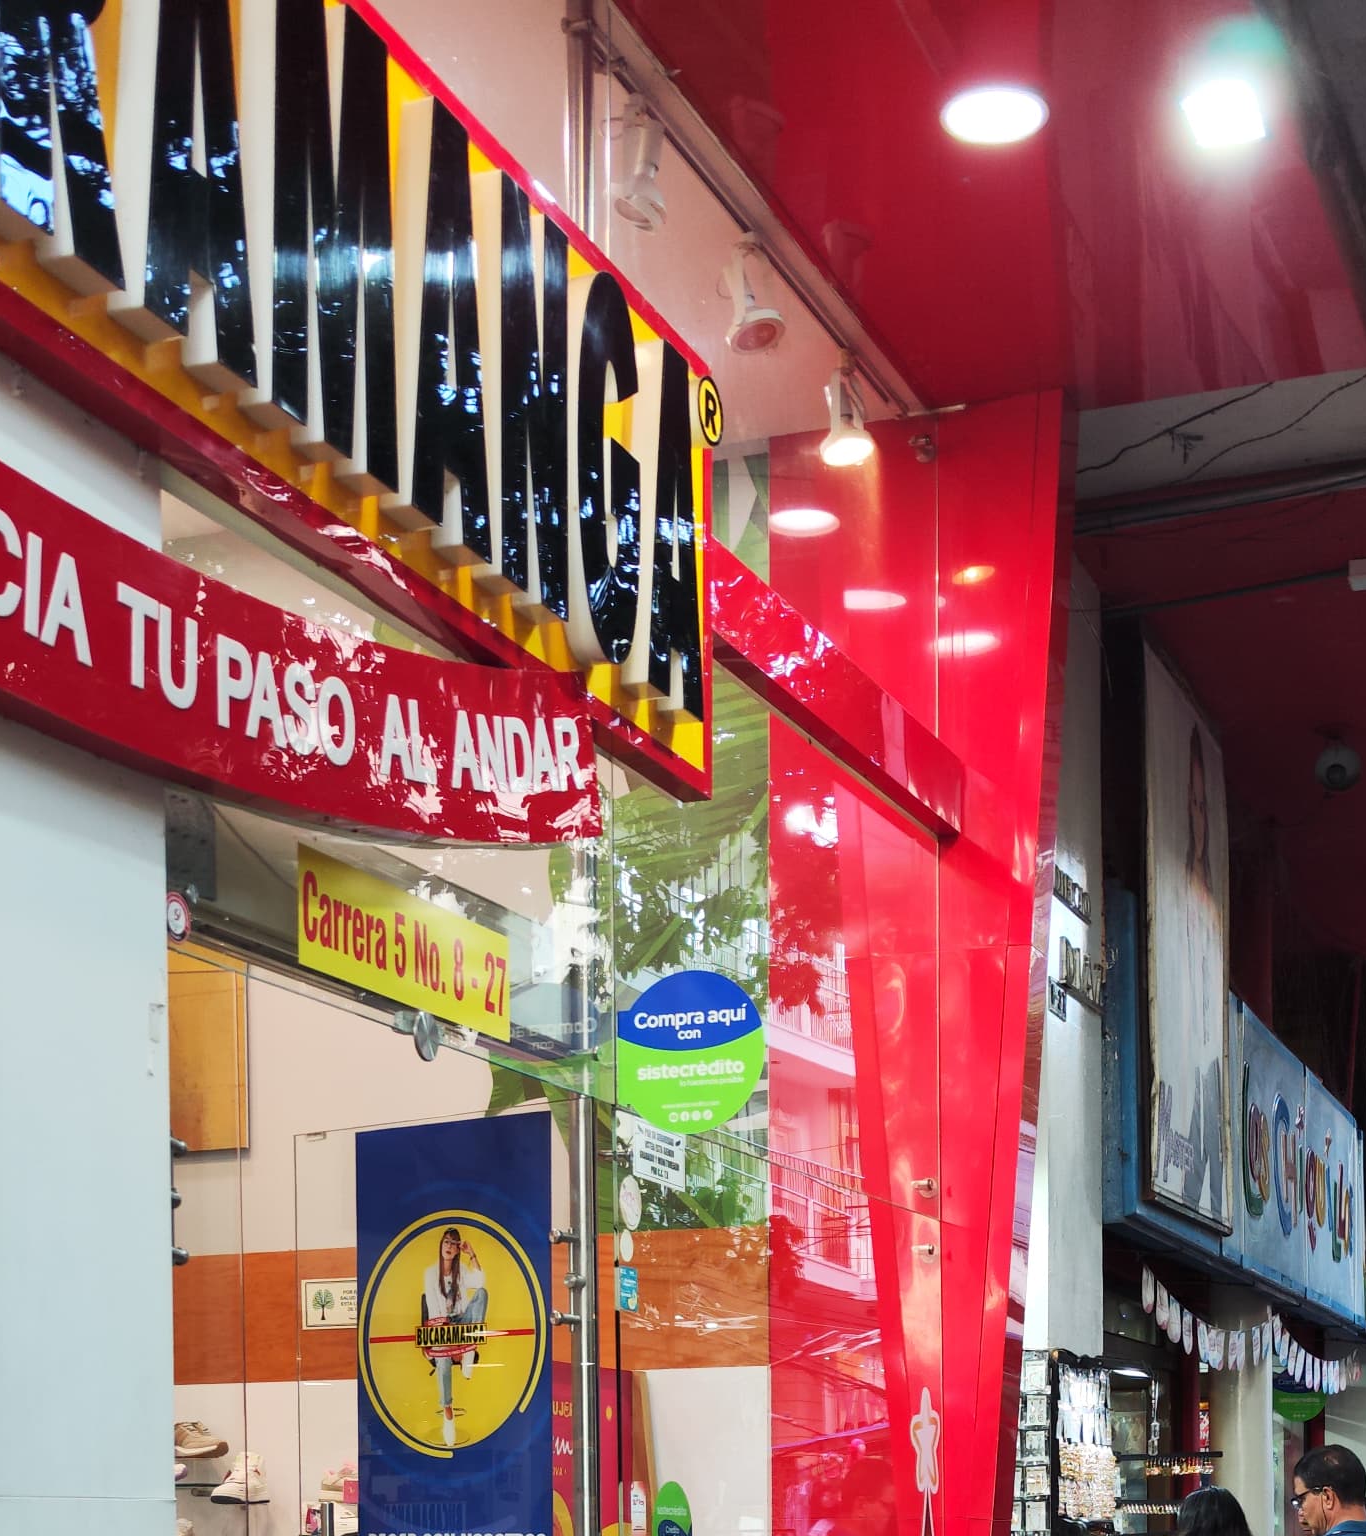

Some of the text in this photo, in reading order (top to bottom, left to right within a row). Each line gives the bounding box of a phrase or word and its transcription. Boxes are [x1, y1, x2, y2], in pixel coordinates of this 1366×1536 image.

[117, 581, 199, 711] TU
[217, 634, 356, 767] PASO
[379, 693, 437, 786] AL
[451, 710, 585, 793] ANDAR
[303, 870, 388, 971] Carrera
[394, 911, 407, 978] 5
[414, 920, 446, 994] No.
[453, 938, 464, 1001] 8
[485, 951, 506, 1016] 27
[634, 1003, 748, 1031] Compra aquí
[677, 1028, 701, 1040] con
[637, 1059, 745, 1080] sistecrédito
